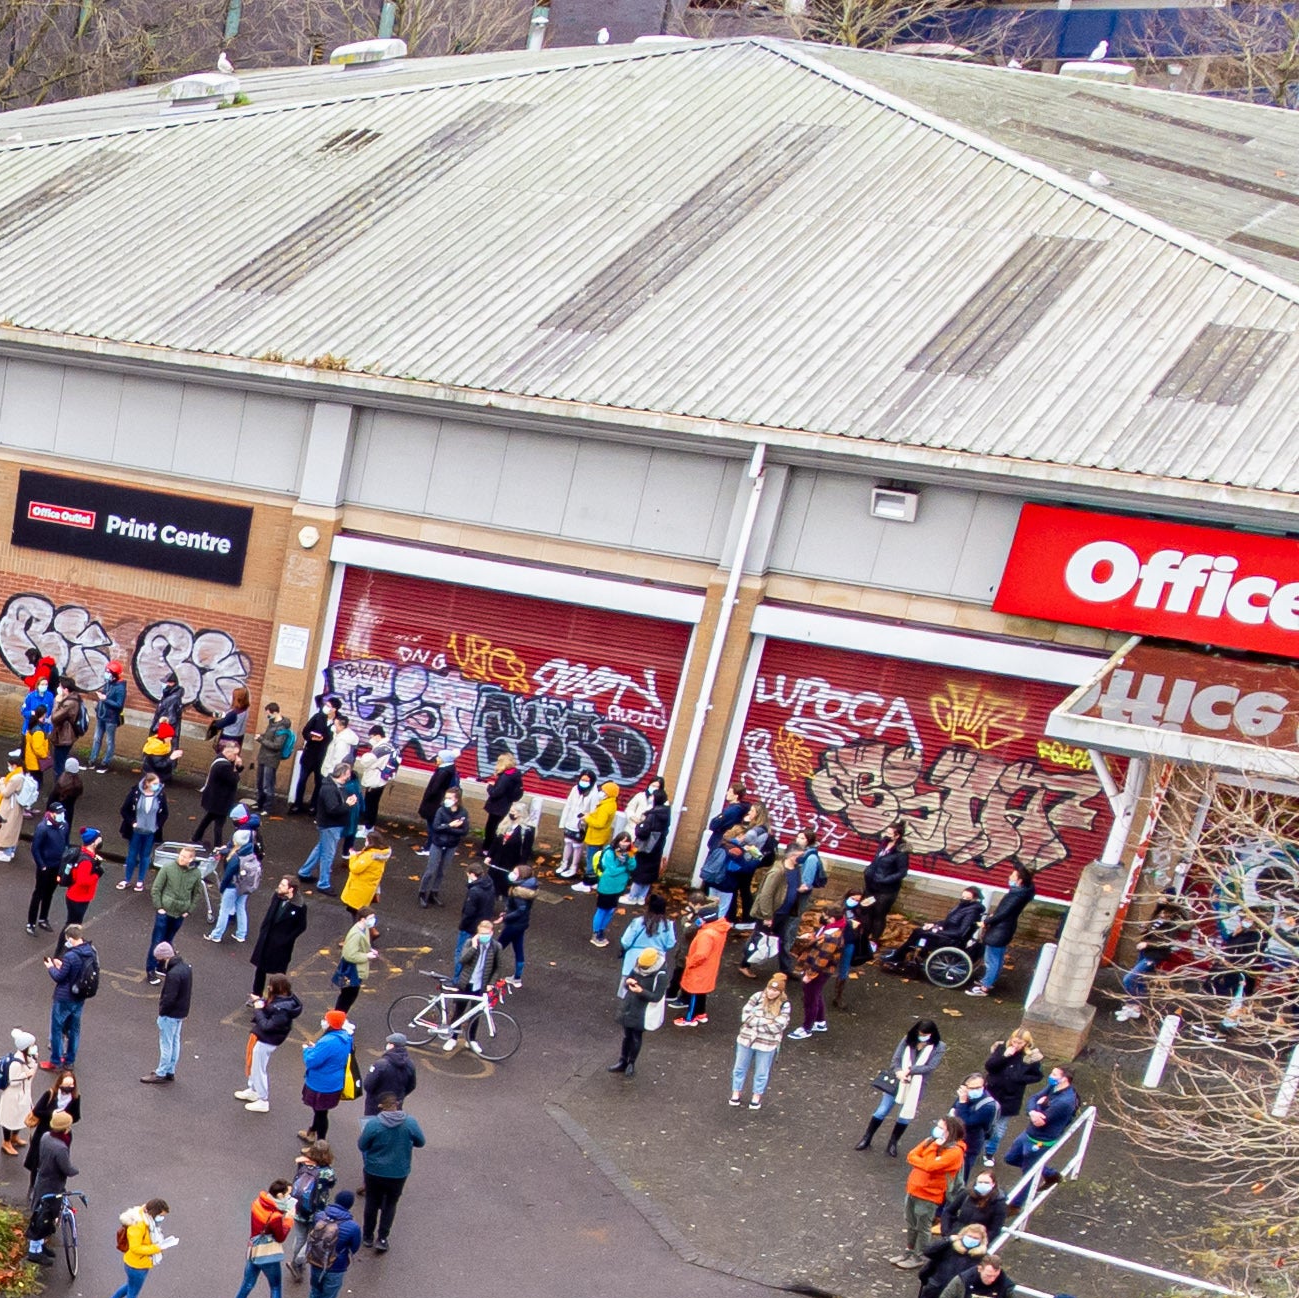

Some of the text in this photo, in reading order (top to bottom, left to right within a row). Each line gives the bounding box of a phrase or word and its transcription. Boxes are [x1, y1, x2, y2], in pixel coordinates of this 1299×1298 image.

[32, 506, 91, 526] Office Outlet
[105, 514, 232, 555] Print Centre
